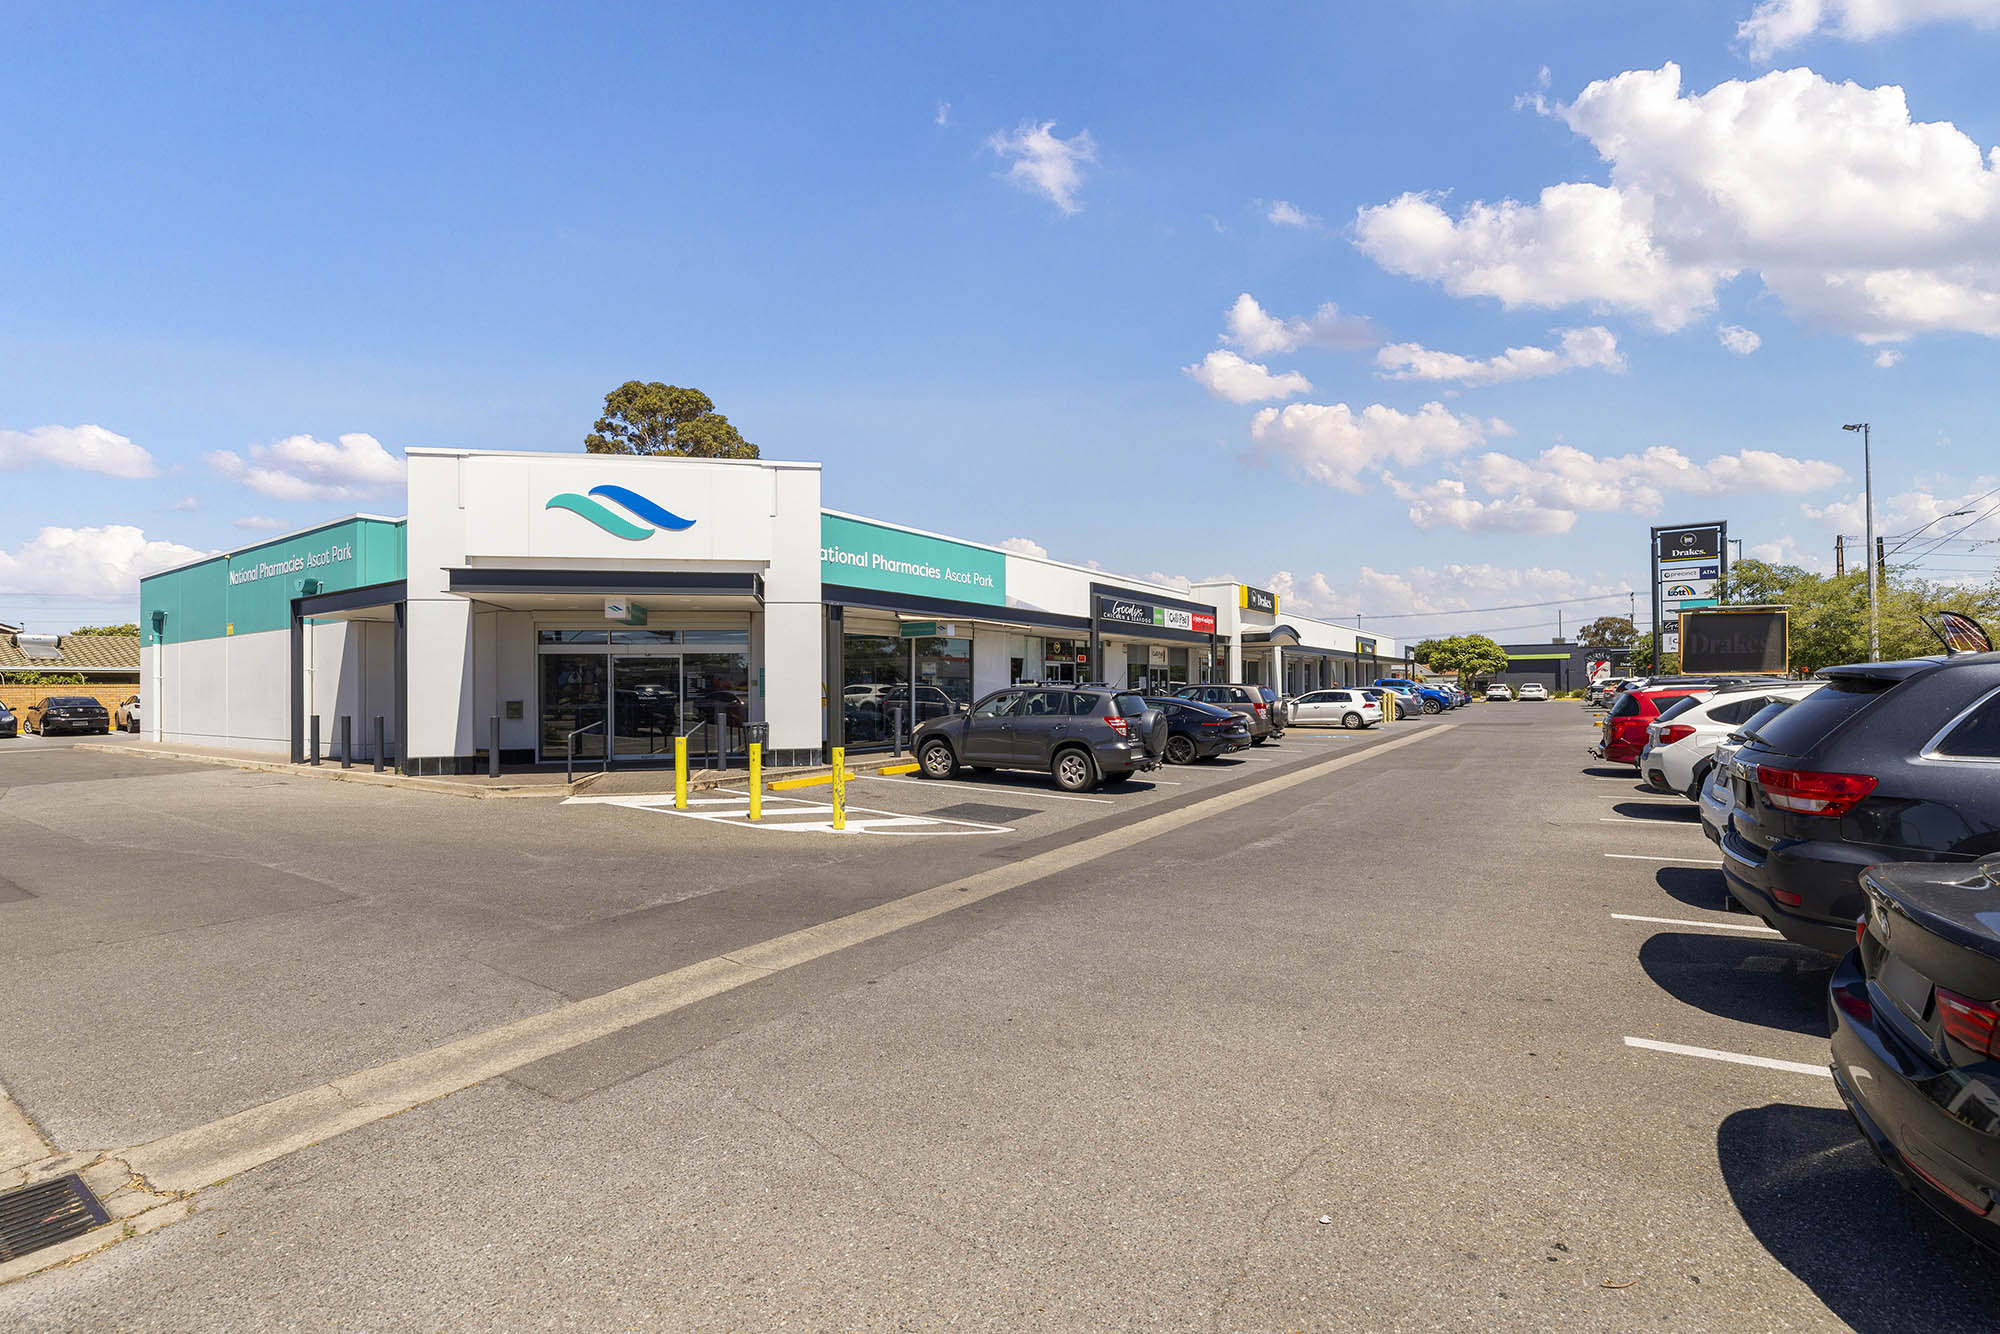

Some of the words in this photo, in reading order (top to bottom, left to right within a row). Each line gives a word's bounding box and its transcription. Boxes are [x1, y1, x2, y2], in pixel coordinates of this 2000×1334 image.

[229, 563, 258, 586] National
[259, 553, 304, 579] Pharmacies
[306, 549, 330, 569] Ascot
[331, 541, 352, 563] Park
[819, 545, 868, 568] ational
[872, 552, 942, 580] Pharmacies
[944, 567, 972, 585] Ascot
[973, 572, 994, 588] Park
[1670, 570, 1697, 578] precinct
[1103, 611, 1126, 621] CHICKEN
[1131, 615, 1152, 624] SEAFOOD
